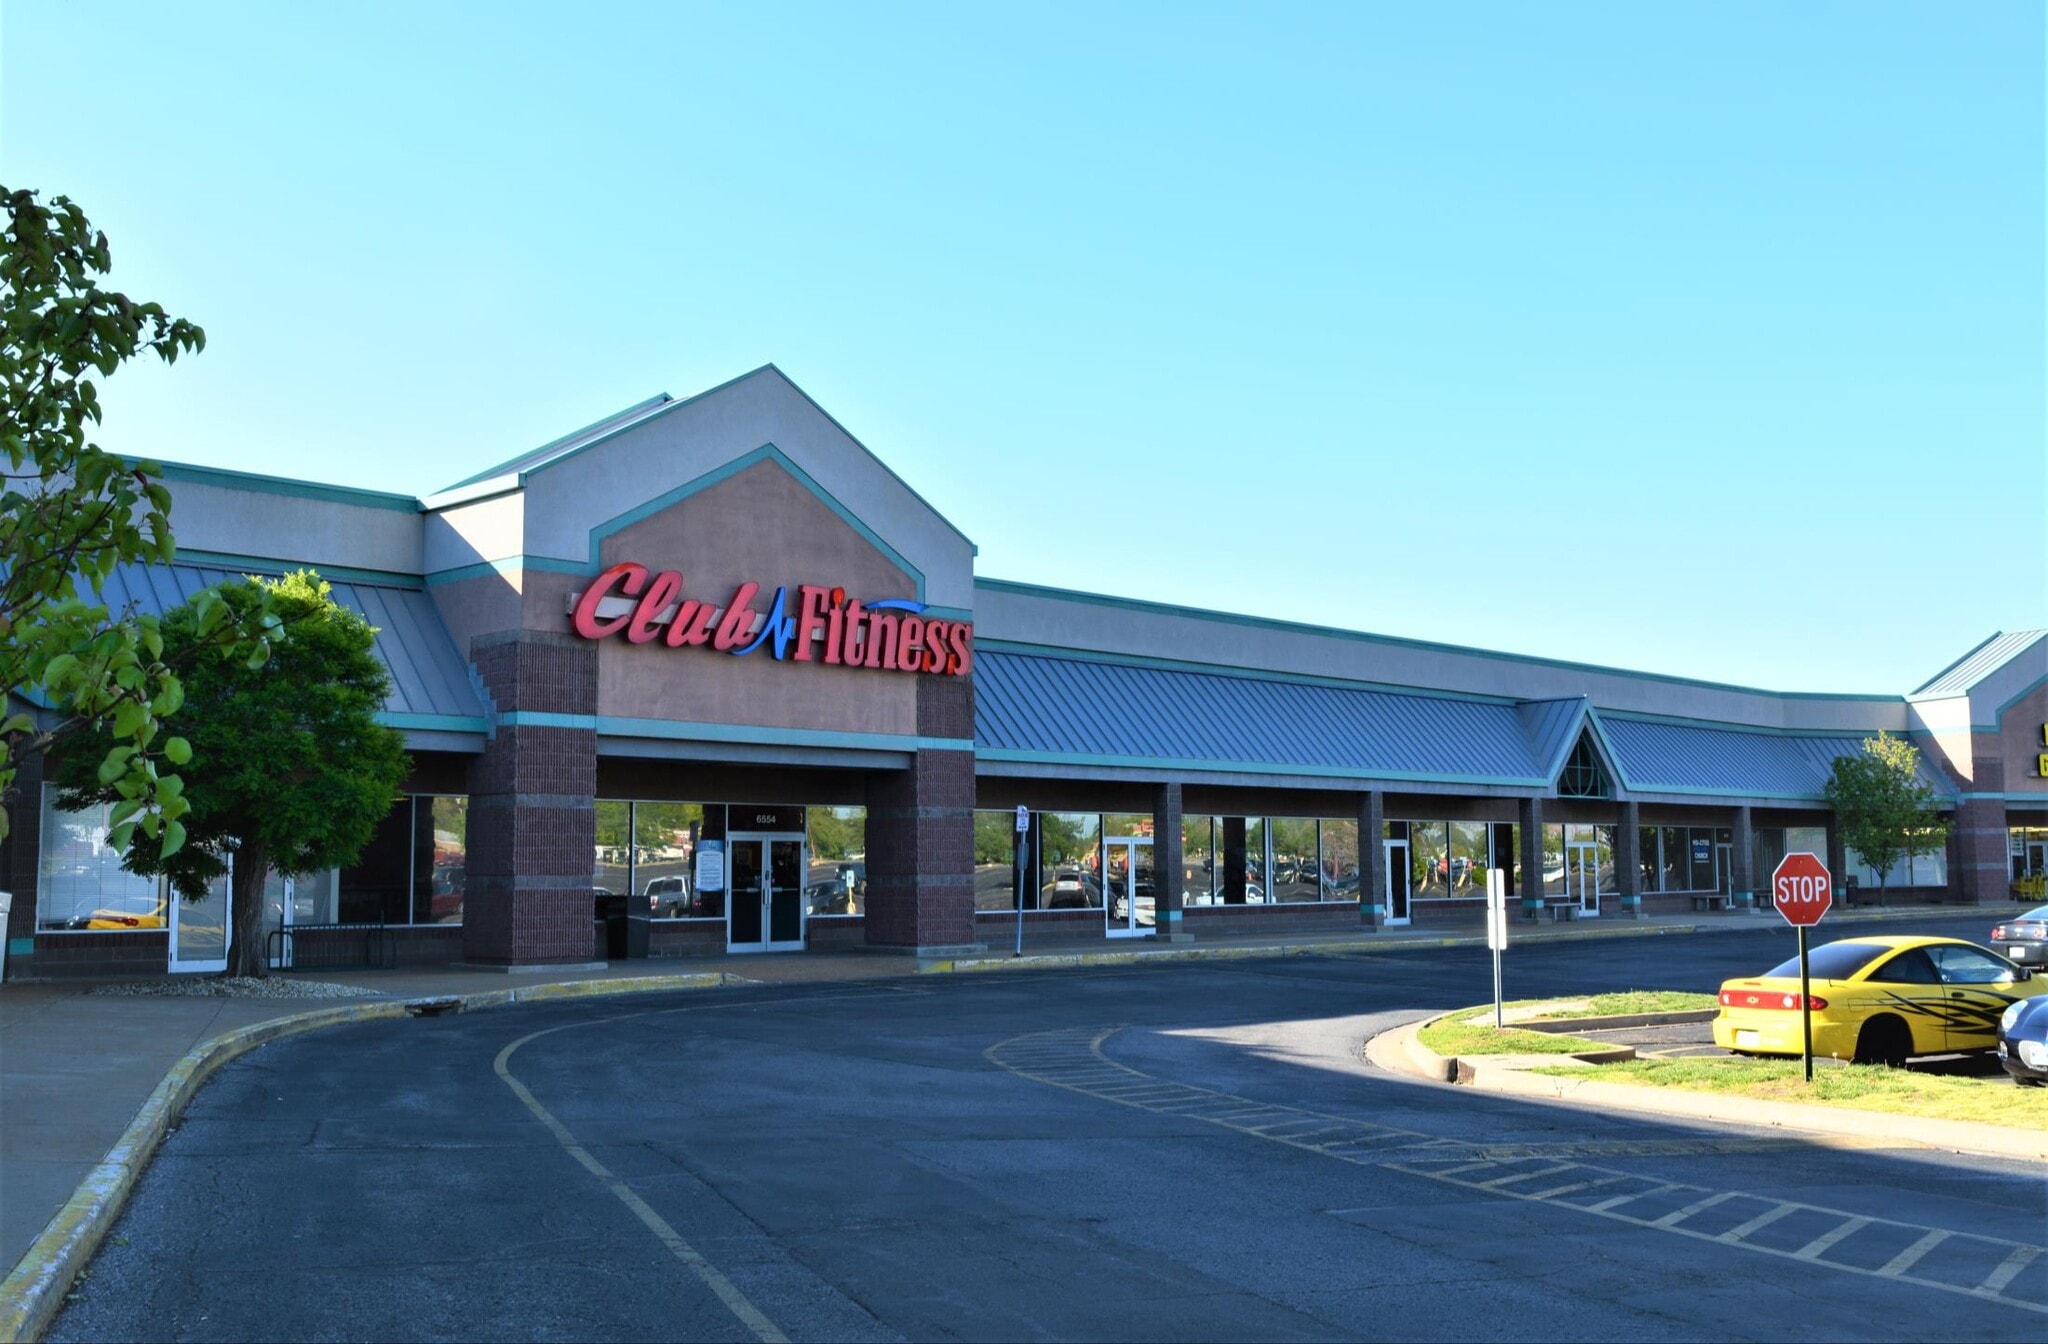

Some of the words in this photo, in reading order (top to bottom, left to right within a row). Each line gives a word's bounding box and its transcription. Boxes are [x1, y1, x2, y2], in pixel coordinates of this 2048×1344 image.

[572, 562, 759, 650] Club
[794, 584, 972, 676] Fitness
[756, 814, 776, 824] 6554
[1778, 875, 1827, 904] STOP
